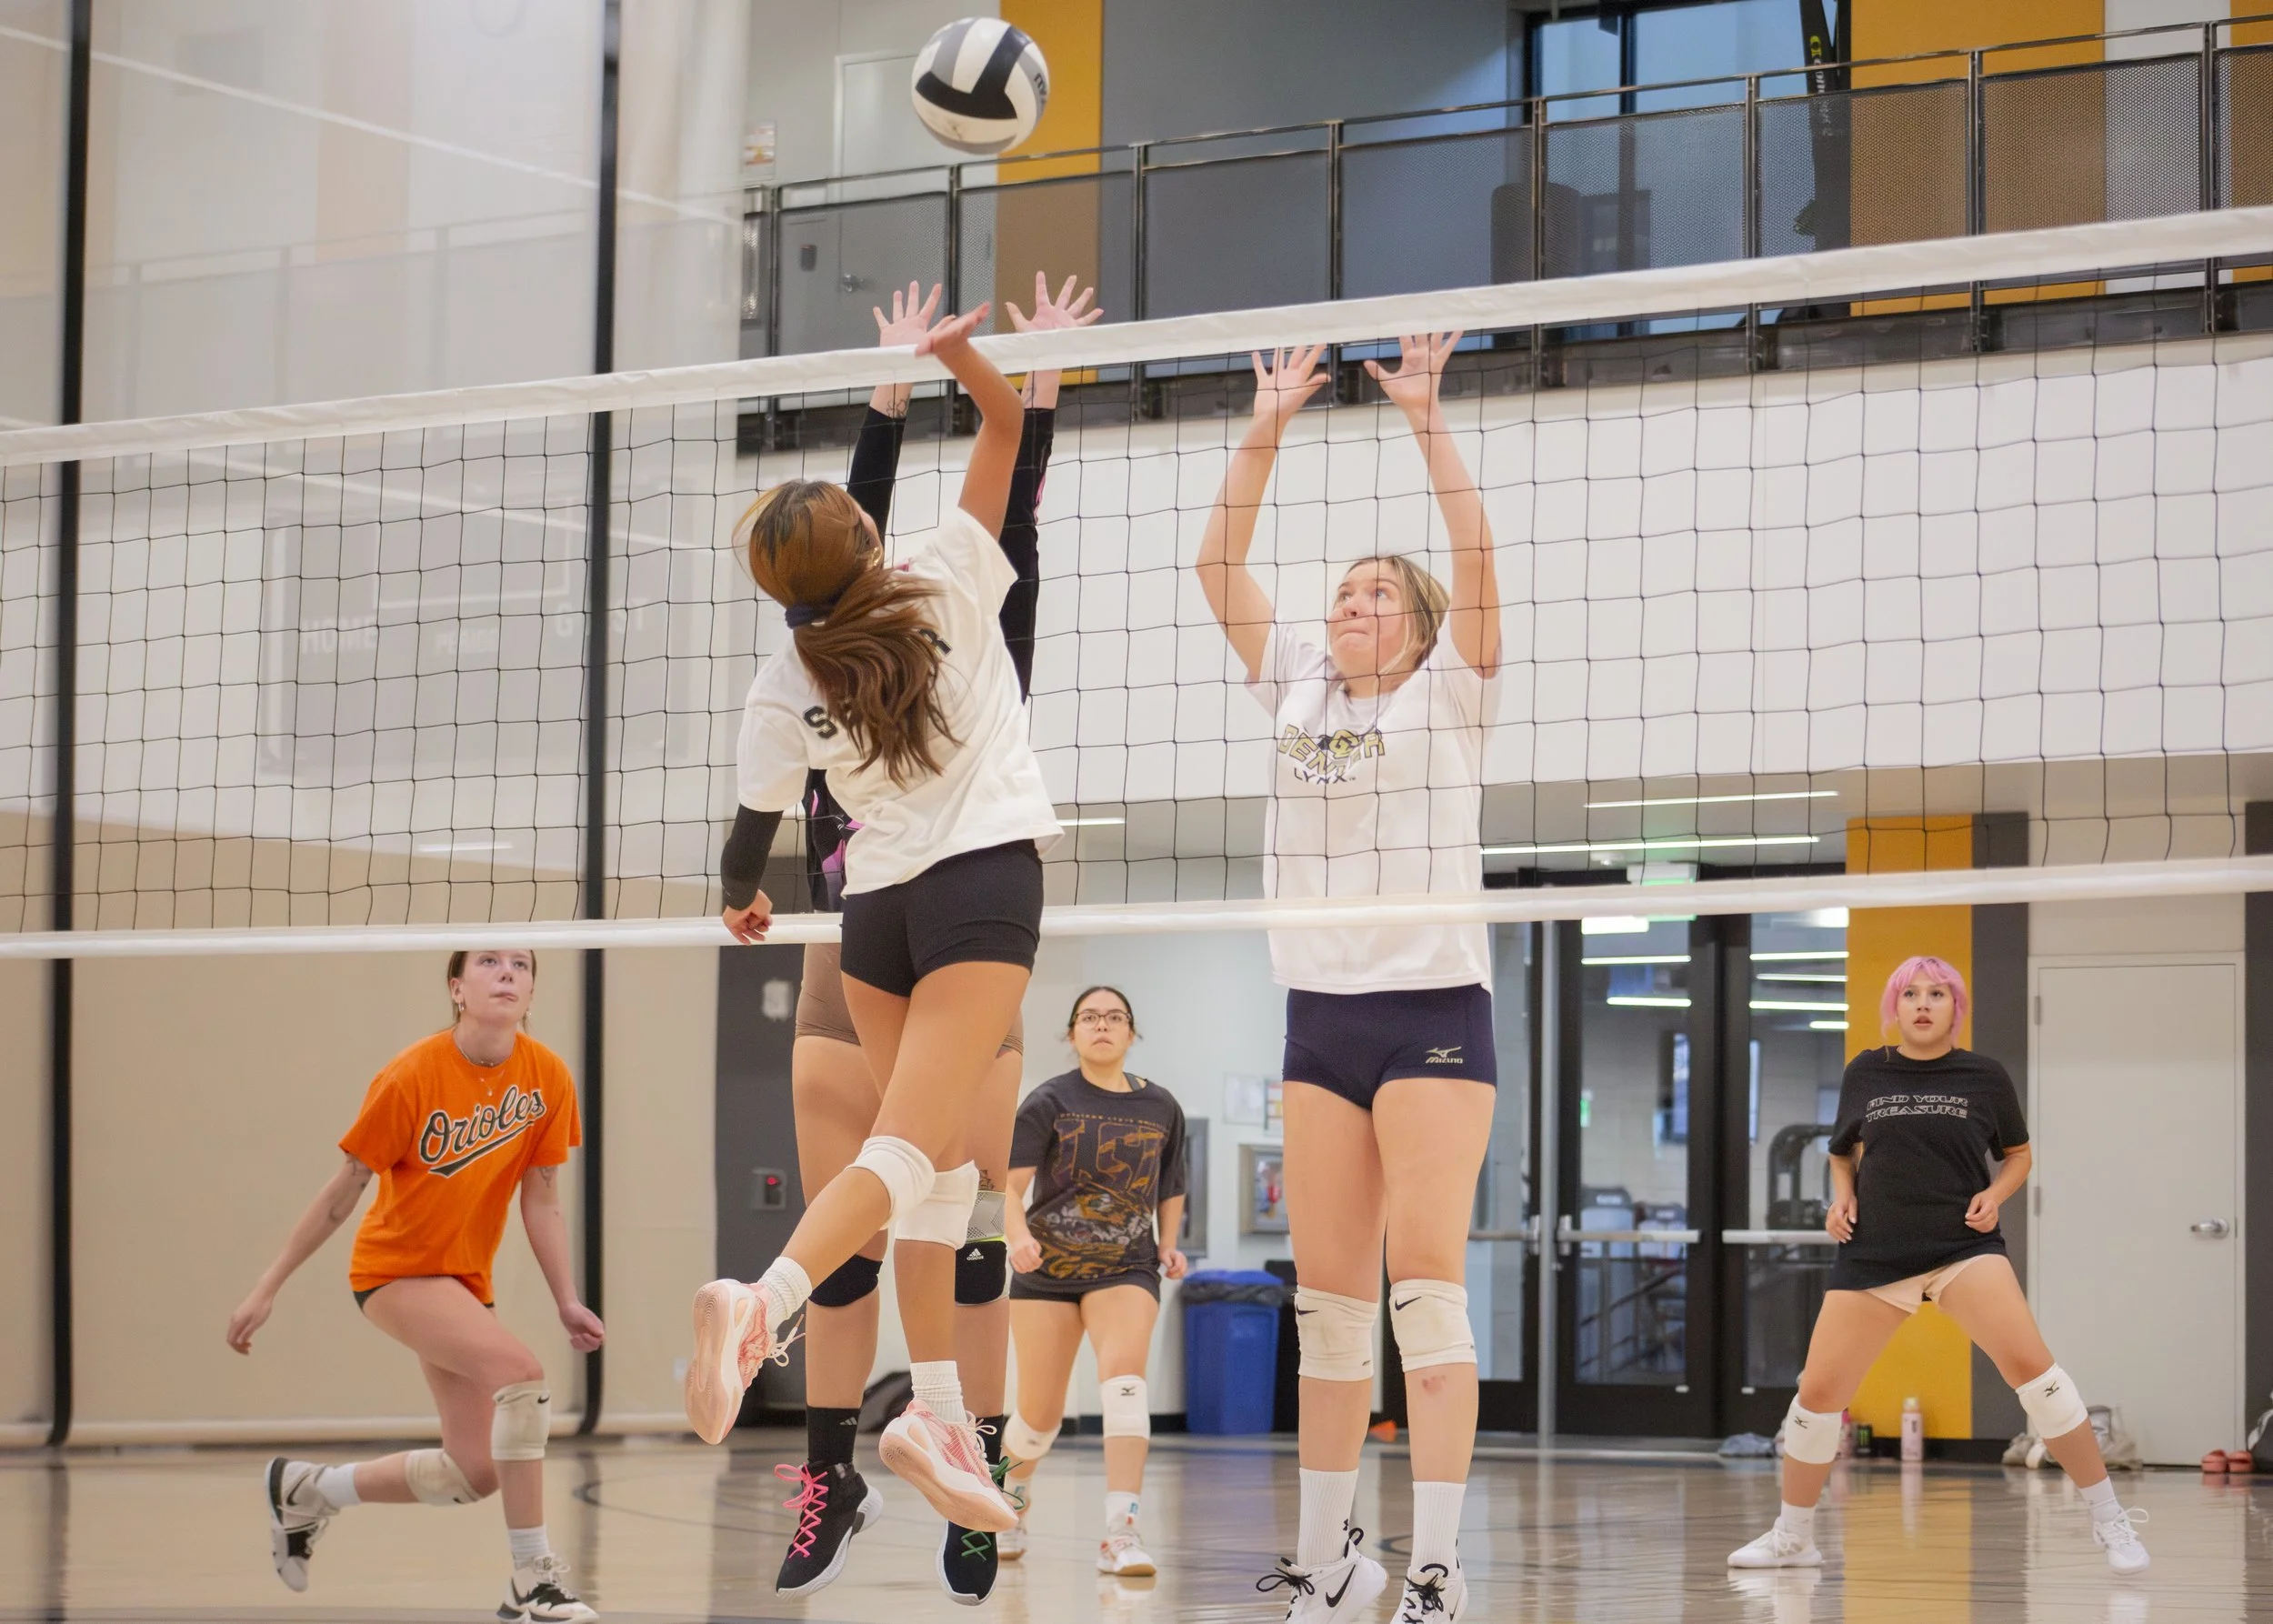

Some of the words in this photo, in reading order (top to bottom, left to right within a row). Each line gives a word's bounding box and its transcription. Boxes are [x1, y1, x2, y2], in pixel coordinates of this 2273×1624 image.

[302, 616, 377, 655] HOME
[556, 596, 649, 638] GST
[1865, 1105, 1968, 1123] TREASURE
[1913, 1095, 1968, 1107] YOUR
[419, 1085, 546, 1165] Orioles
